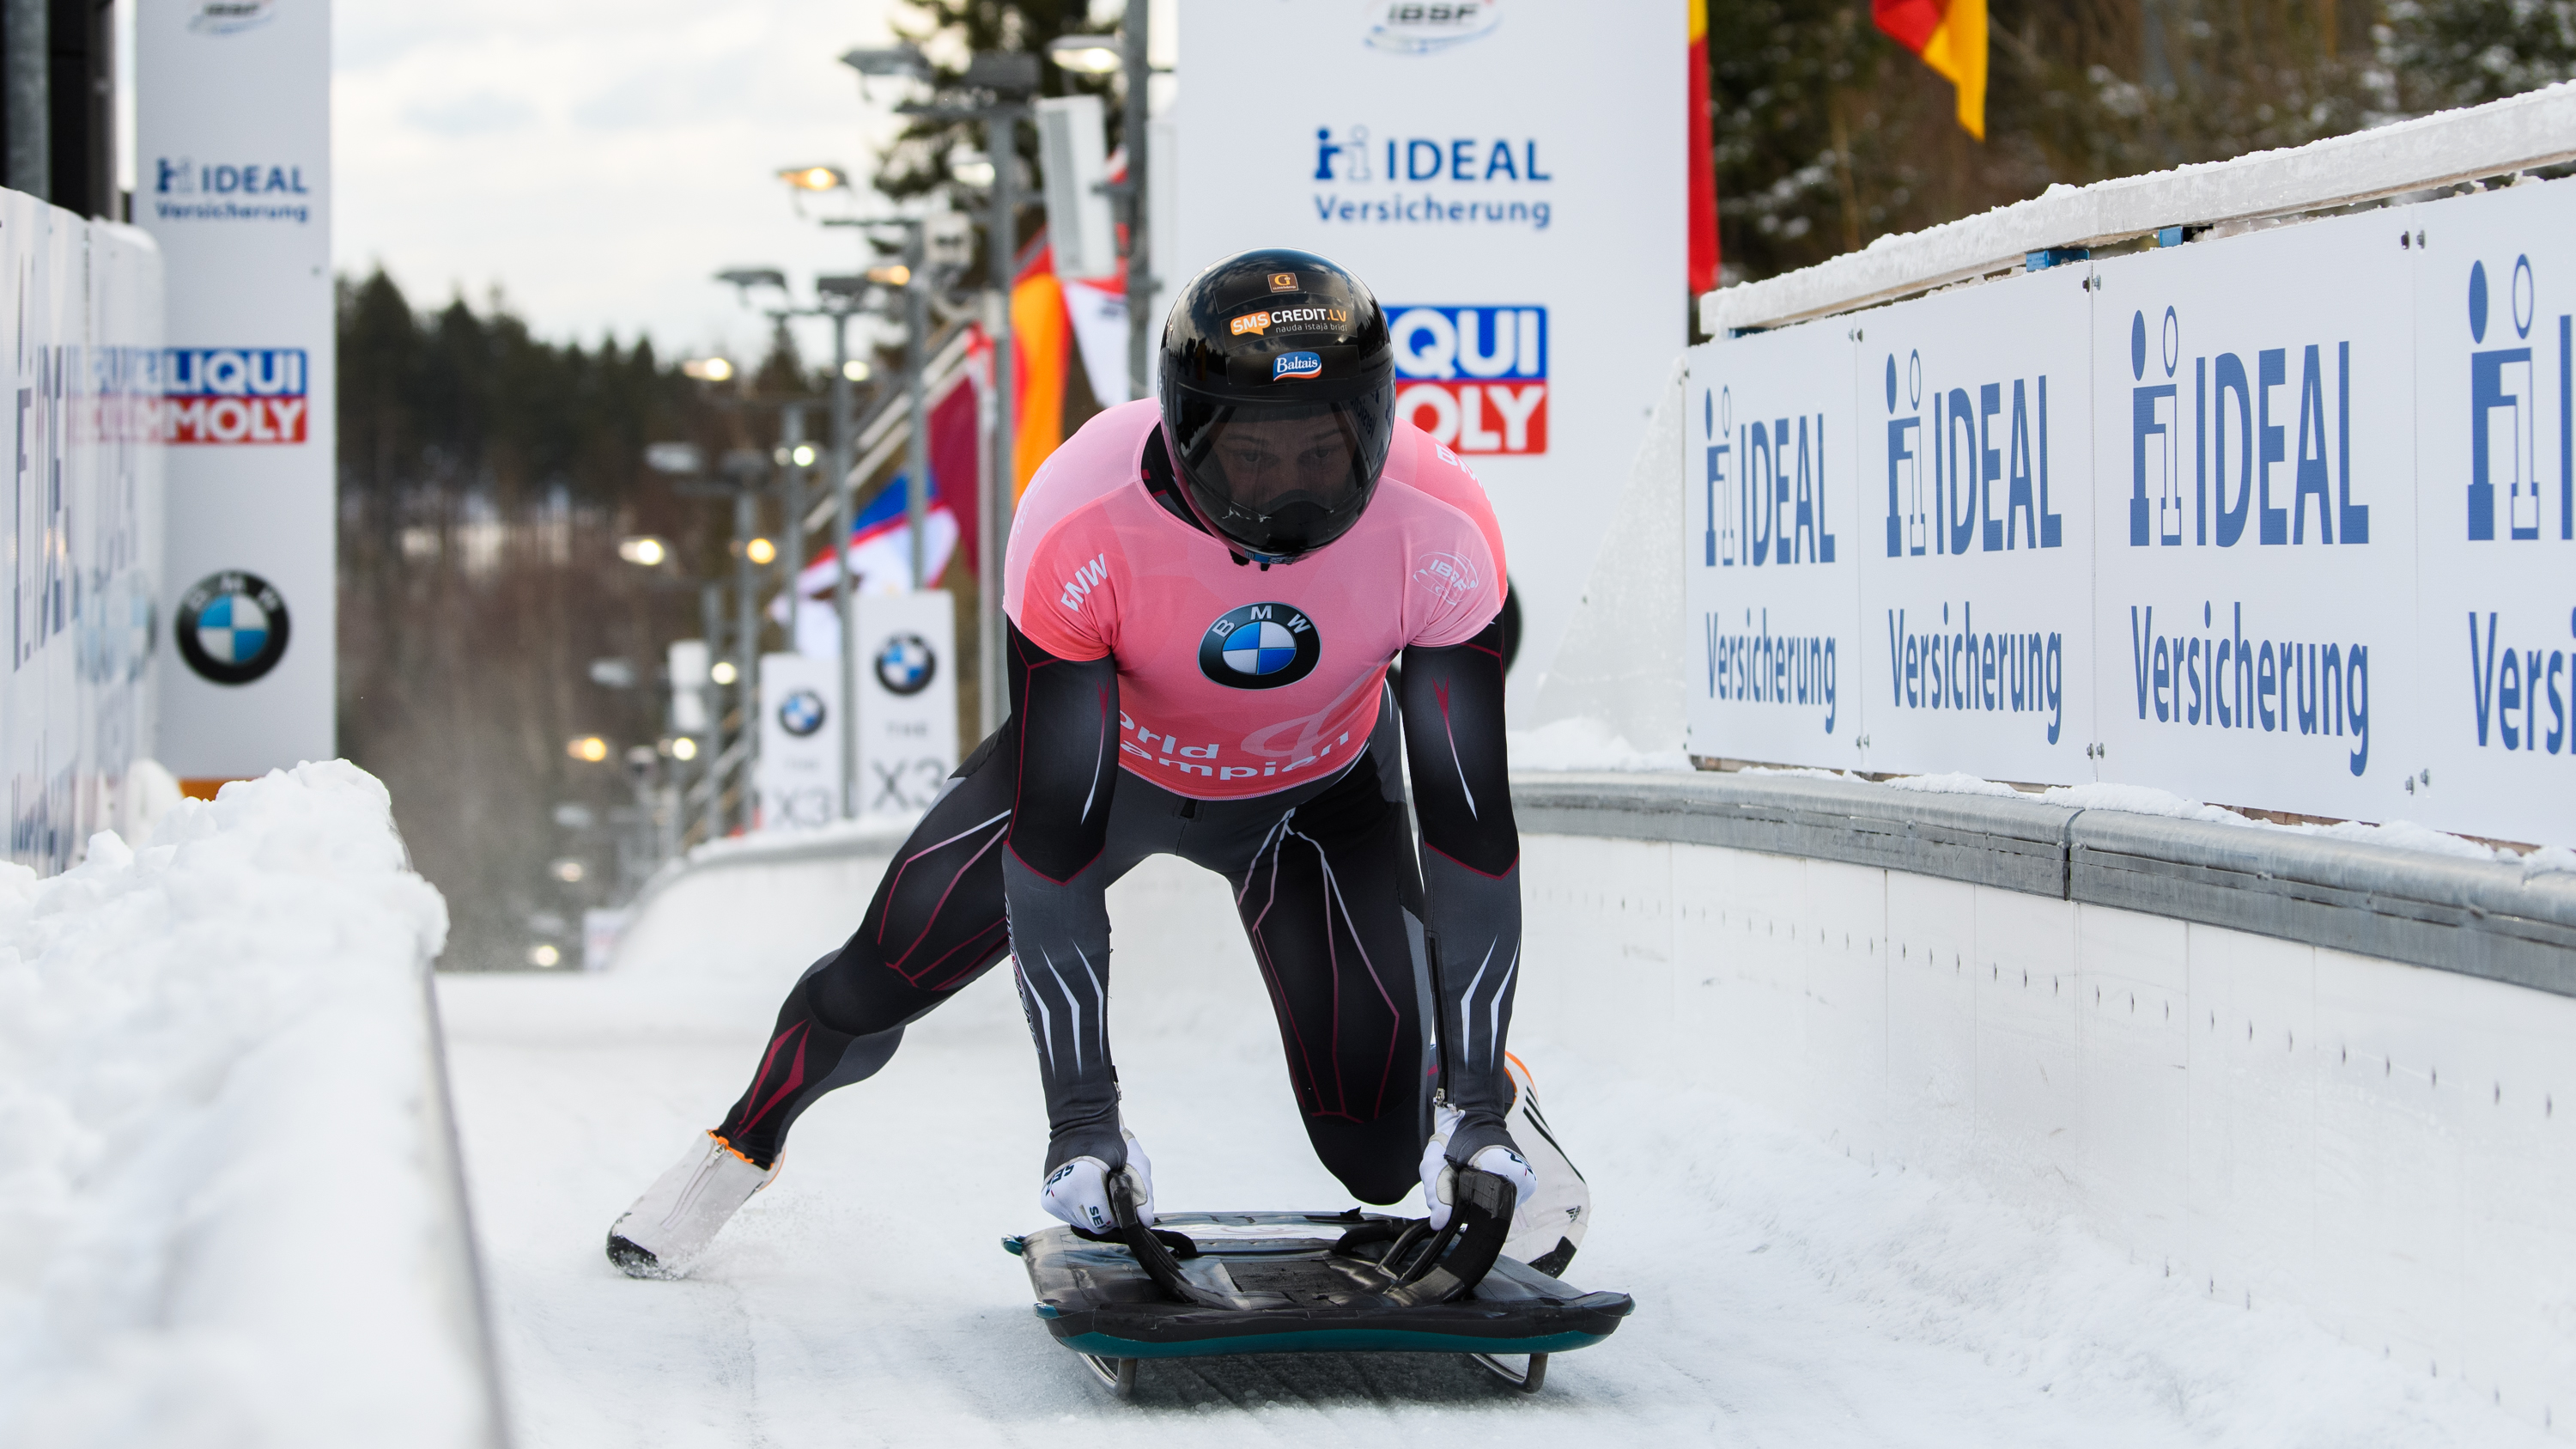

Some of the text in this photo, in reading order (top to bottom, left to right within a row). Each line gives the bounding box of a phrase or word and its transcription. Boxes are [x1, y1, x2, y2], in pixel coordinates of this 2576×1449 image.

[202, 166, 308, 194] IDEAL
[1388, 139, 1552, 180] IDEAL
[155, 203, 308, 223] Versicherung
[1314, 192, 1551, 229] Versicherung
[1275, 324, 1303, 333] nauda
[1384, 307, 1540, 380] QUI
[167, 351, 301, 393] LIQUI
[1276, 356, 1318, 374] Baltais
[166, 398, 302, 439] MOLY
[1394, 384, 1545, 451] OLY
[1934, 374, 2063, 556] IDEAL
[2196, 340, 2370, 548] IDEAL
[1741, 412, 1836, 567] IDEAL
[1212, 605, 1311, 638] BMW
[1705, 607, 1837, 734] Versicherung
[1888, 601, 2063, 746] Versicherung
[2130, 600, 2369, 777] Versicherung
[1119, 709, 1219, 759] orld
[1120, 731, 1349, 781] ampion
